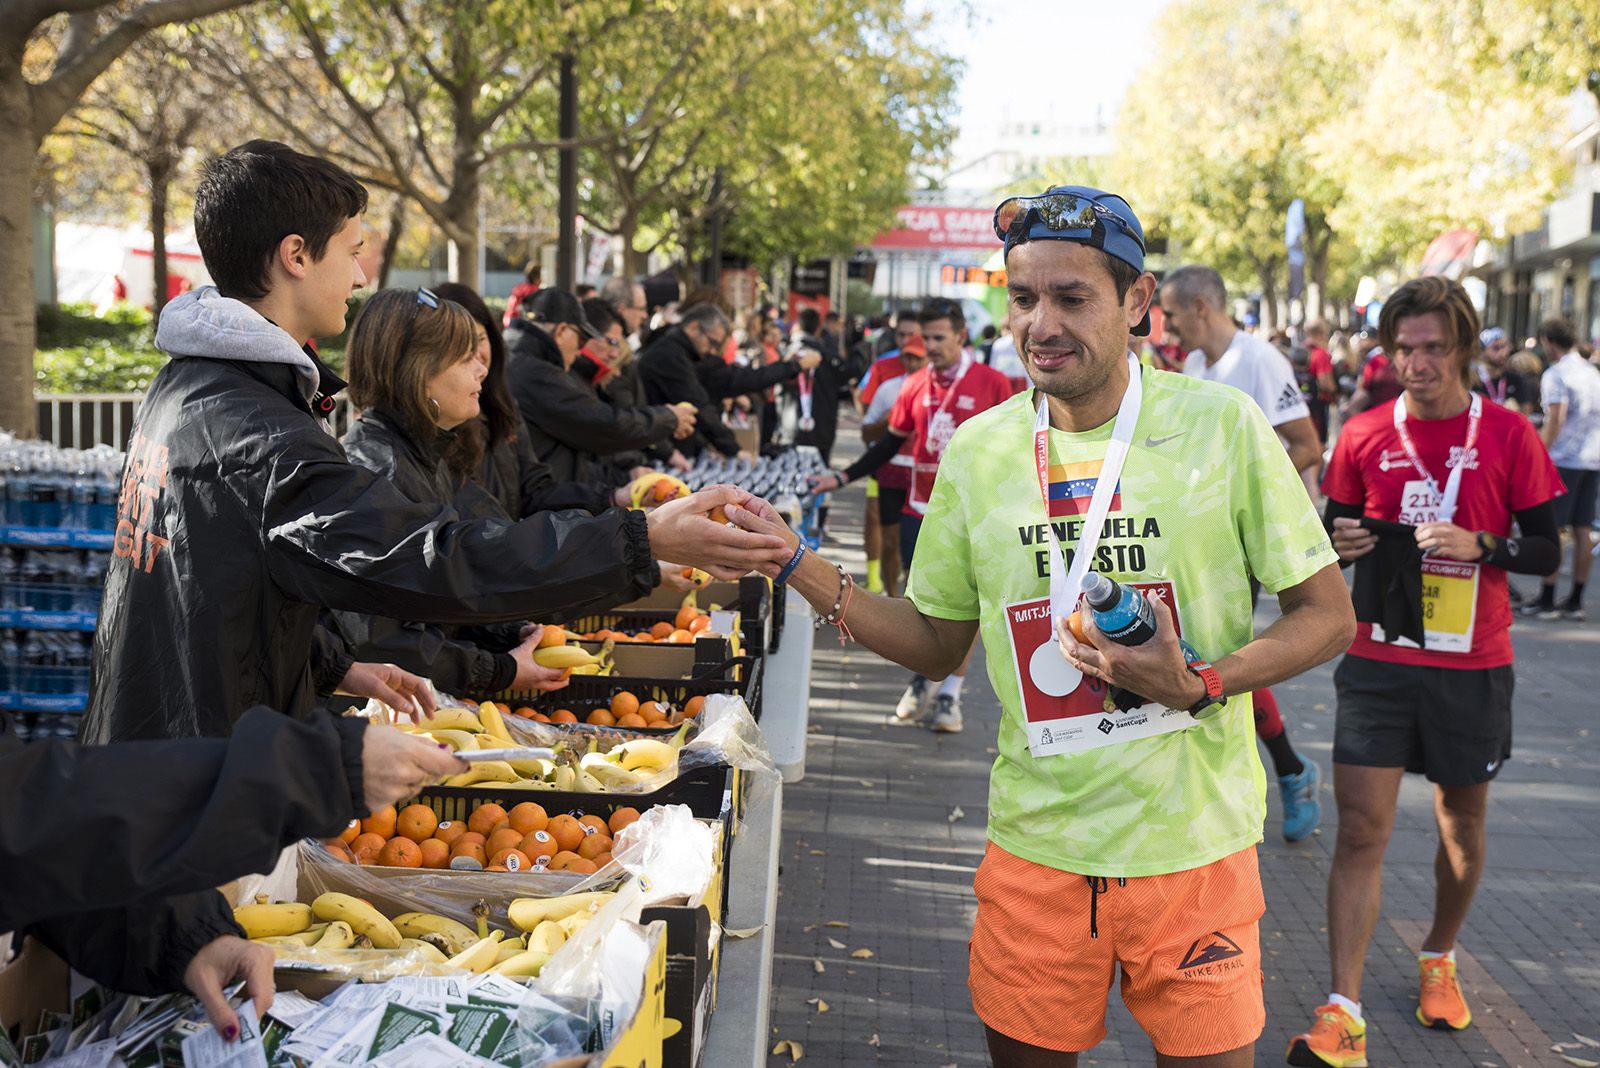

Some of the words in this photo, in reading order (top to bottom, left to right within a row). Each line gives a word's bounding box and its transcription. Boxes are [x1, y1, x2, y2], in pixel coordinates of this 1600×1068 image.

[1398, 511, 1440, 525] SAN
[1018, 517, 1161, 546] VENEUELA
[1116, 717, 1149, 729] SantCugat
[1184, 966, 1212, 979] NIKE
[1217, 959, 1245, 973] TRAIL
